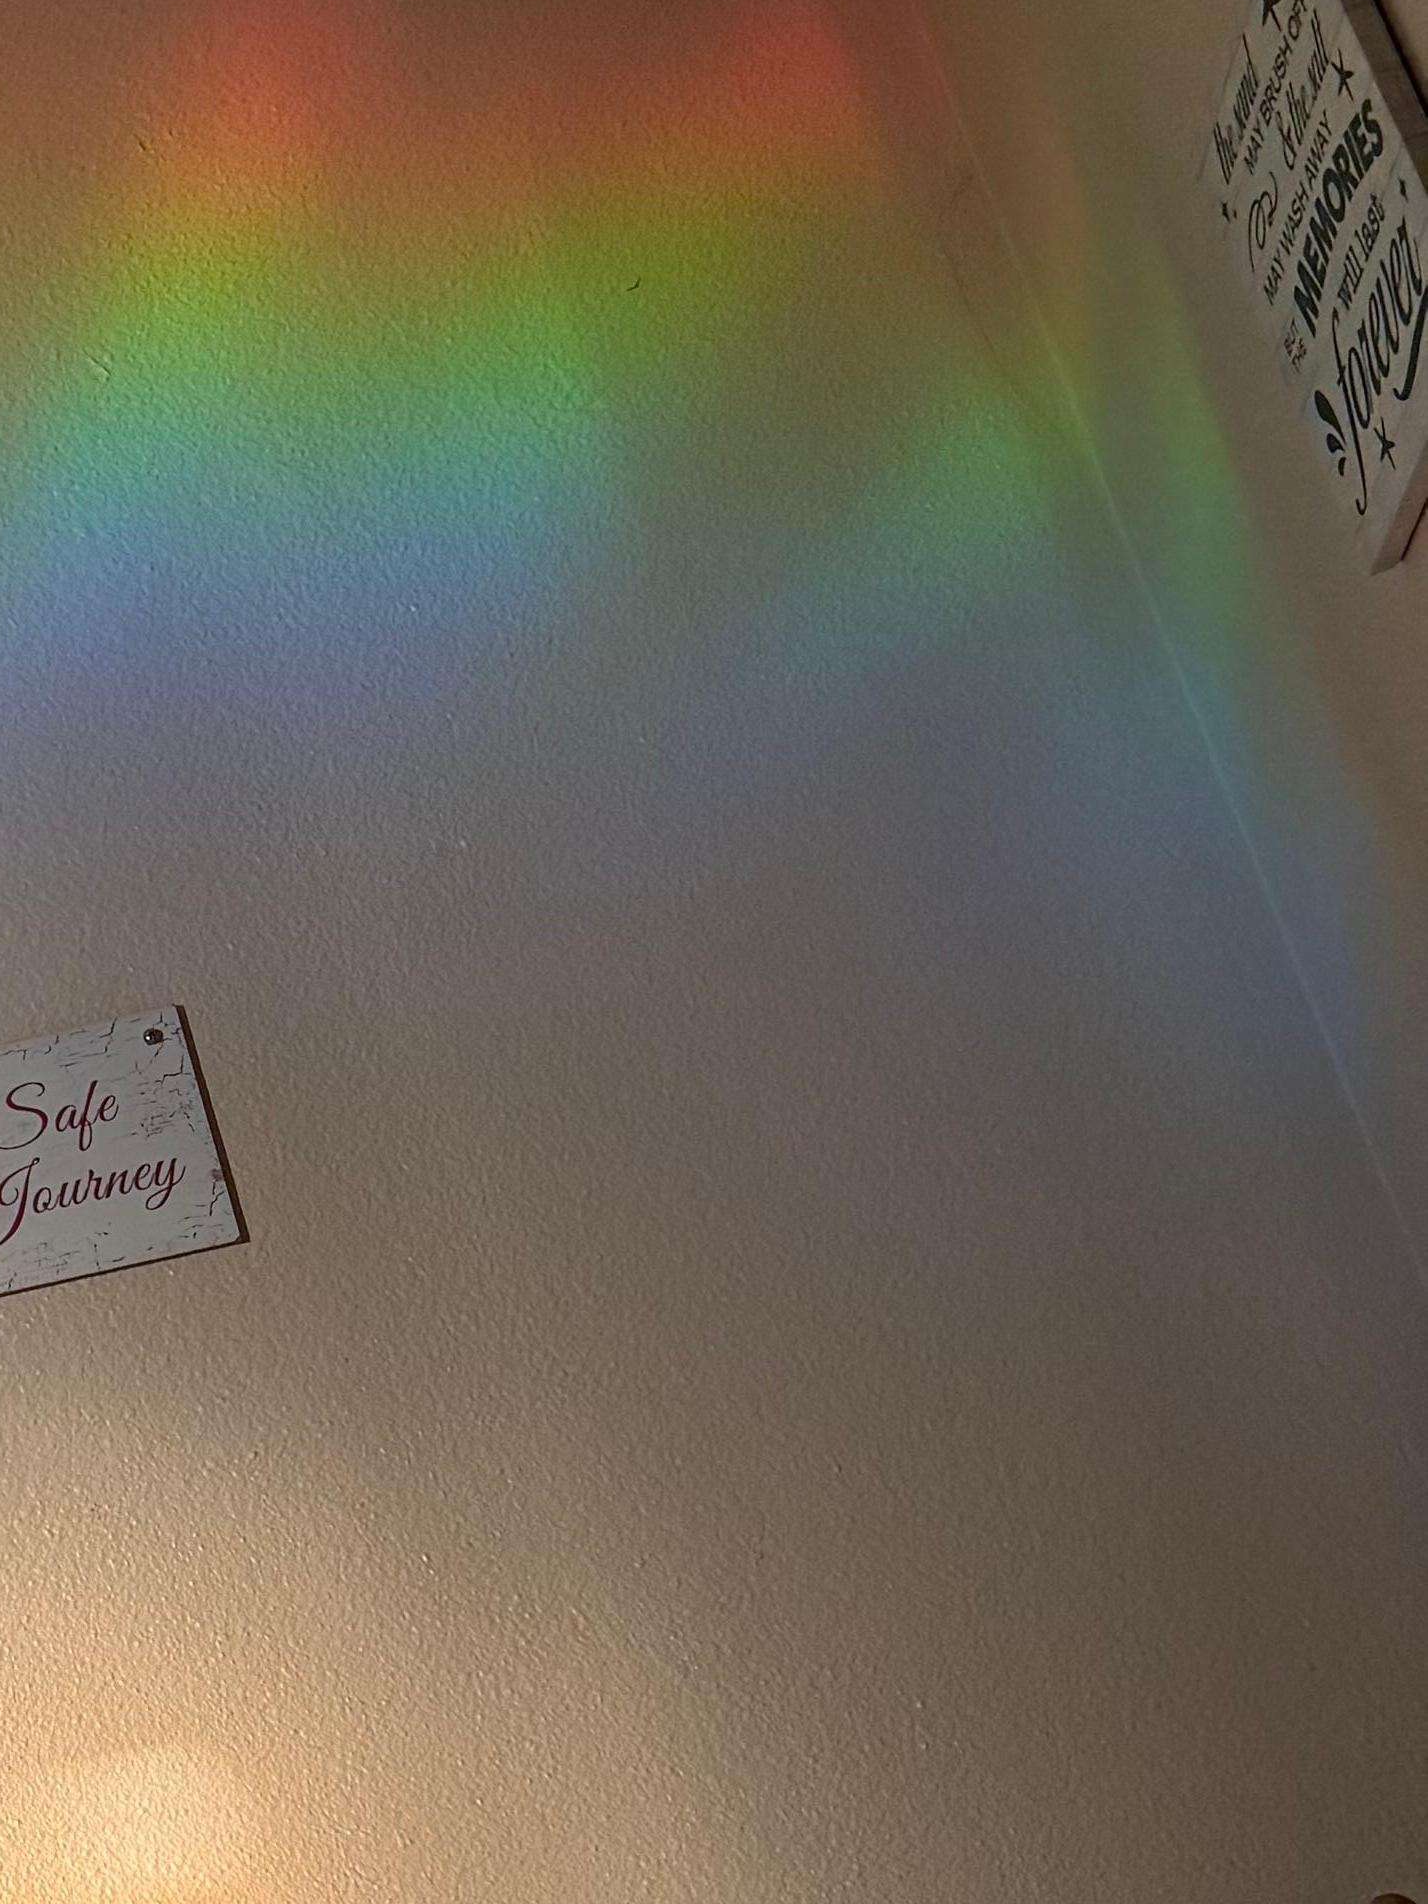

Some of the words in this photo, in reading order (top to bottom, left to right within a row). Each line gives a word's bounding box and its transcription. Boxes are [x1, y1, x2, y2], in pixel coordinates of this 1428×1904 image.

[1212, 121, 1238, 185] the
[1243, 114, 1264, 176] MAY
[1258, 33, 1293, 128] BRUSH
[1274, 109, 1297, 171] &
[1284, 80, 1314, 147] the
[1262, 246, 1285, 306] MAY
[1277, 179, 1310, 256] WASH
[1303, 108, 1332, 193] AWAY
[1293, 97, 1383, 338] MEMORIES
[1336, 243, 1364, 311] will
[1353, 191, 1385, 263] last
[1331, 214, 1422, 516] forever
